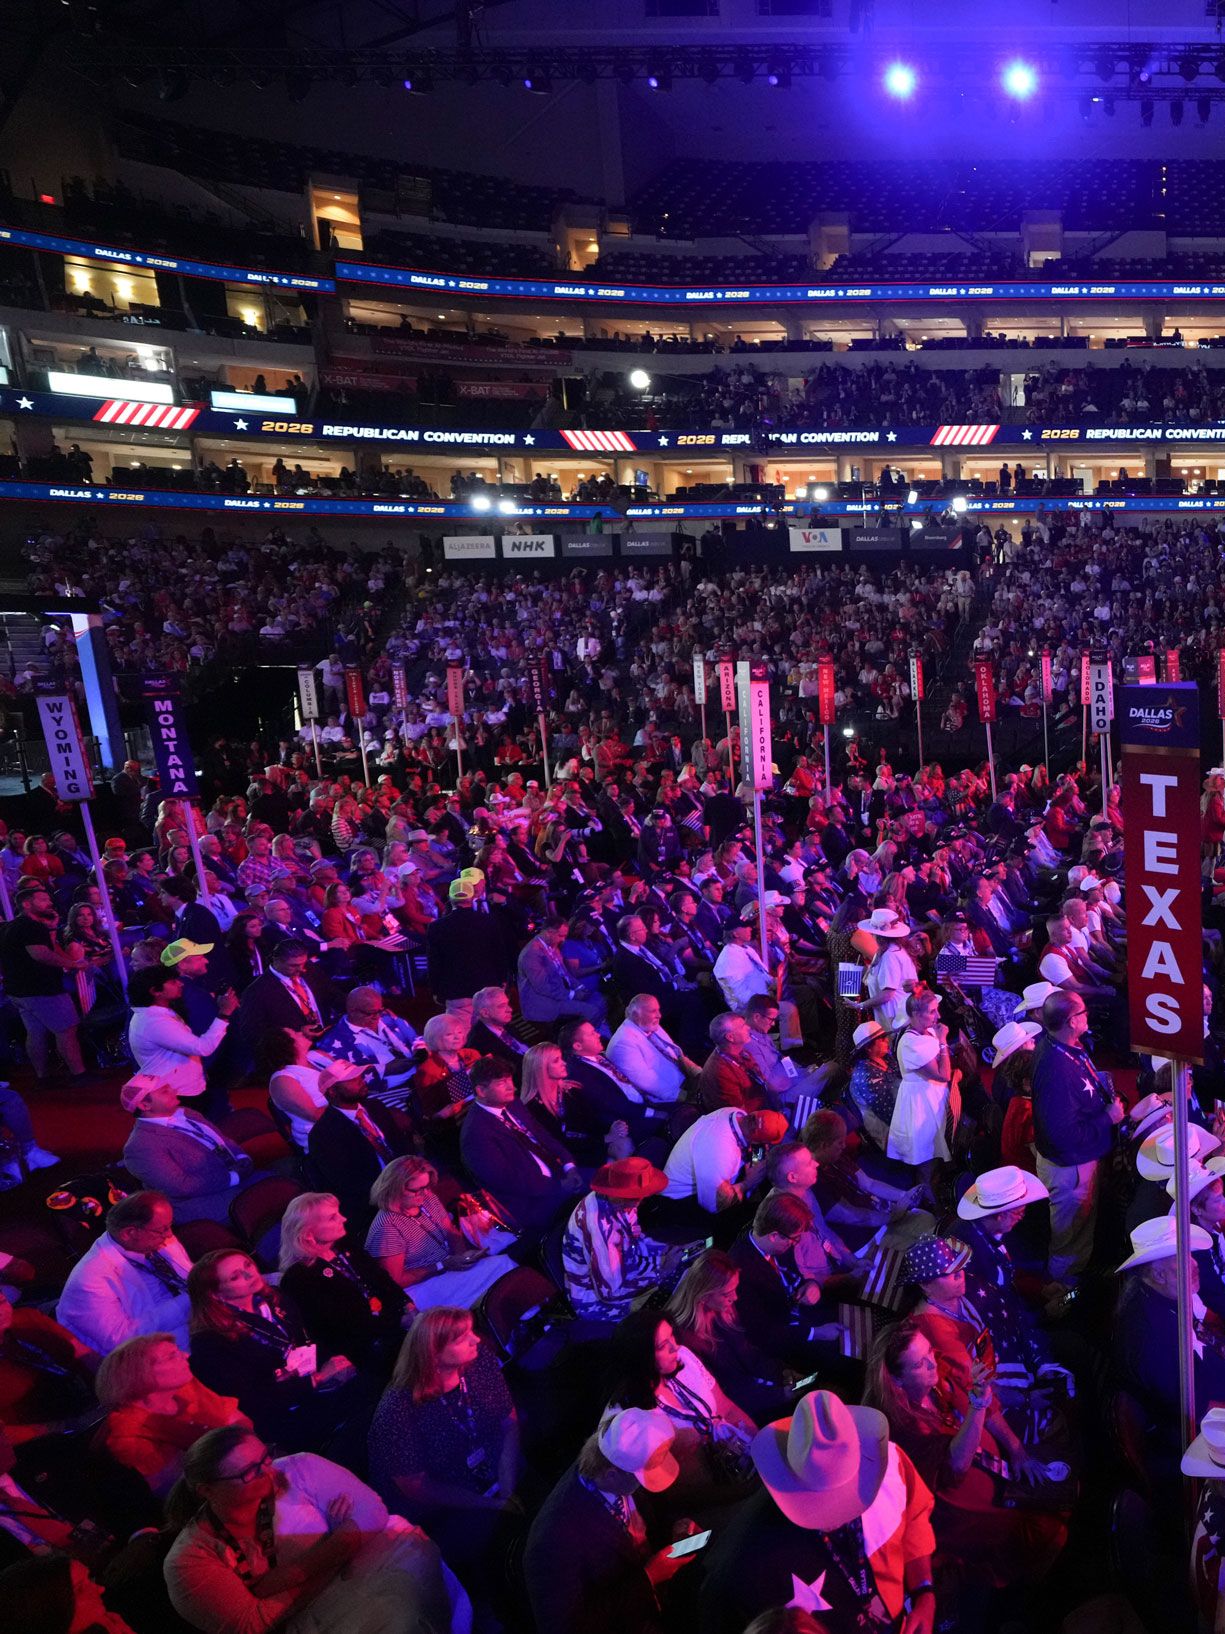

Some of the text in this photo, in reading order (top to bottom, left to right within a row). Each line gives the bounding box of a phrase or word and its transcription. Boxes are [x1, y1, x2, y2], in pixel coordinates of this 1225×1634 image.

[95, 249, 131, 260] DALLAS
[411, 276, 445, 285] DALLAS
[460, 385, 490, 395] X-BAT
[262, 422, 515, 443] 2026 REPUBLICAN CONVENTION
[678, 435, 715, 444] 2026
[801, 432, 879, 442] CONVENTION
[1041, 430, 1079, 438] 2026
[1086, 429, 1162, 438] REPUBLICAN
[50, 489, 91, 498] DALLAS
[511, 540, 545, 552] NHK
[531, 669, 544, 711] GEORGIA
[723, 665, 732, 708] ARIZONA
[980, 666, 990, 718] OKLAHOMA
[1095, 669, 1106, 728] IDAHO
[1129, 707, 1173, 719] DALLAS
[45, 702, 80, 794] WYOMING
[154, 700, 189, 793] MONTANA
[742, 690, 750, 781] CALIFORNIA
[757, 690, 766, 781] CALIFORNIA
[1139, 773, 1184, 1036] TEXAS
